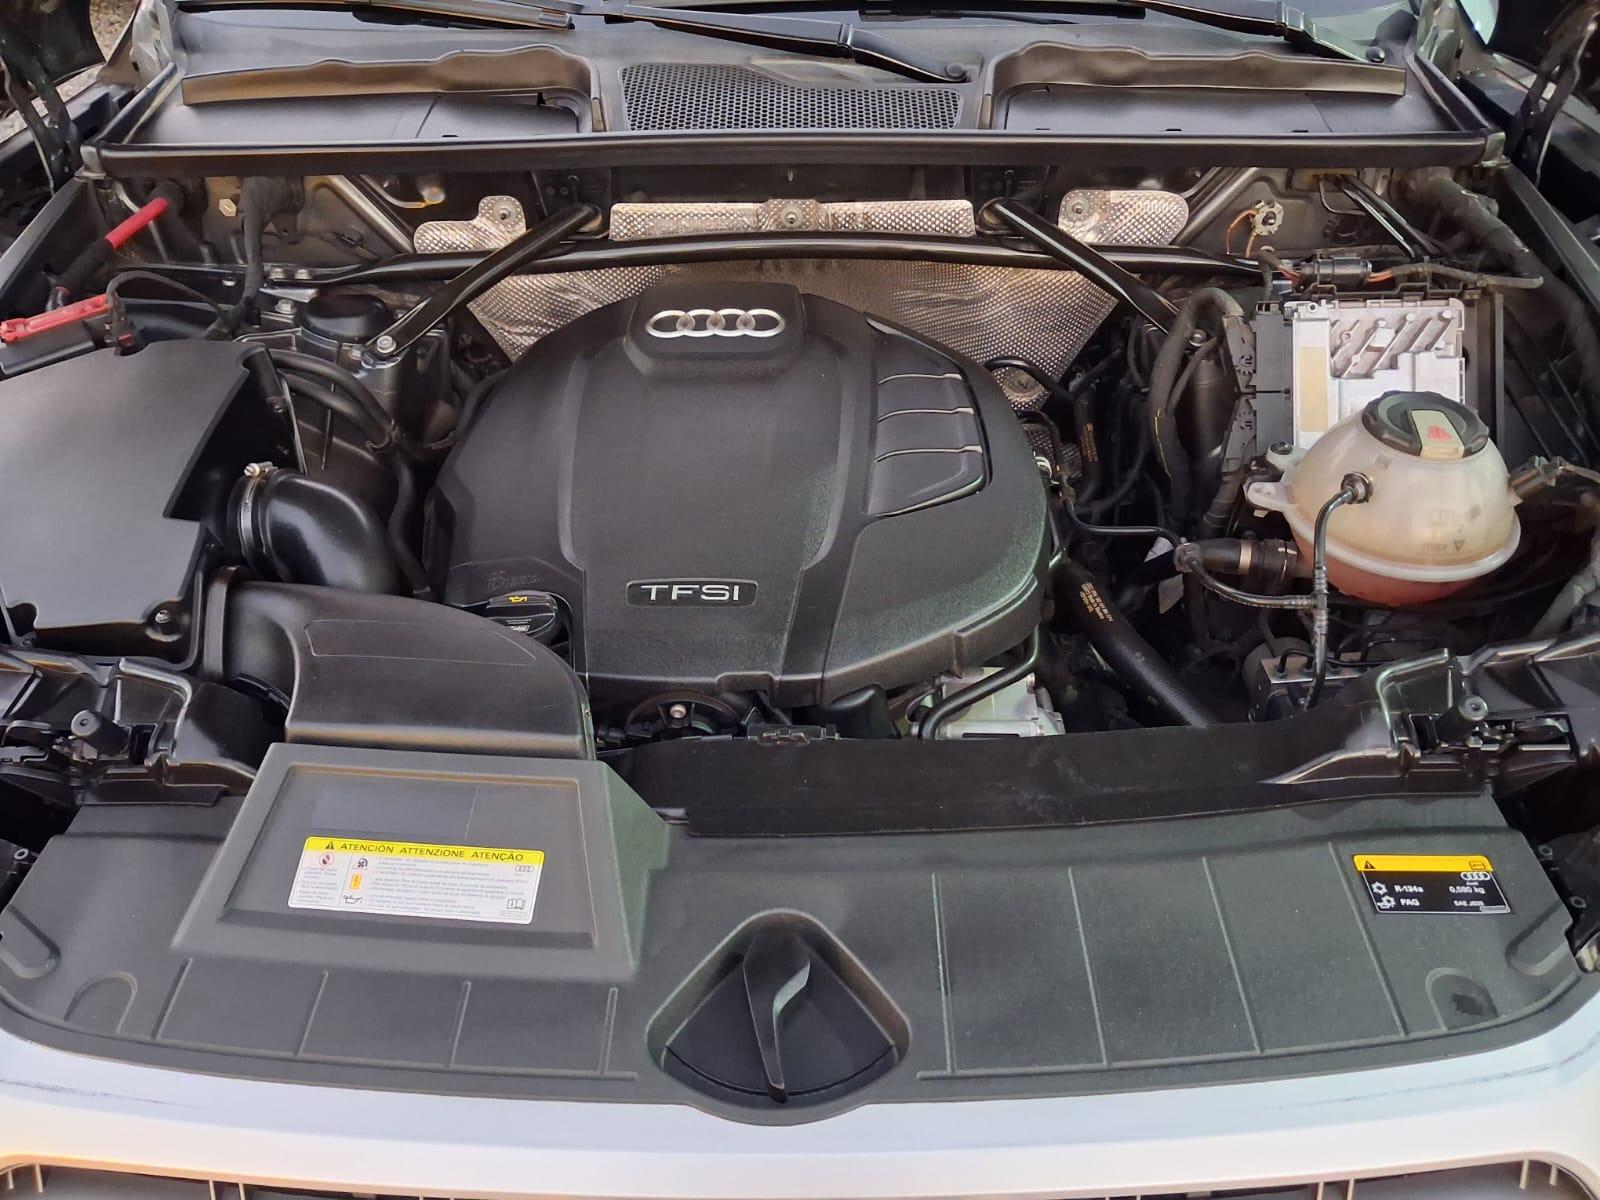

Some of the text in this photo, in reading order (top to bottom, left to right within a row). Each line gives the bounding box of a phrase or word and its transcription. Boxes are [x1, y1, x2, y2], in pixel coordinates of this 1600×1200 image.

[640, 584, 740, 601] TFSI
[399, 847, 465, 858] ATTENZIONE
[1399, 898, 1420, 906] PAG
